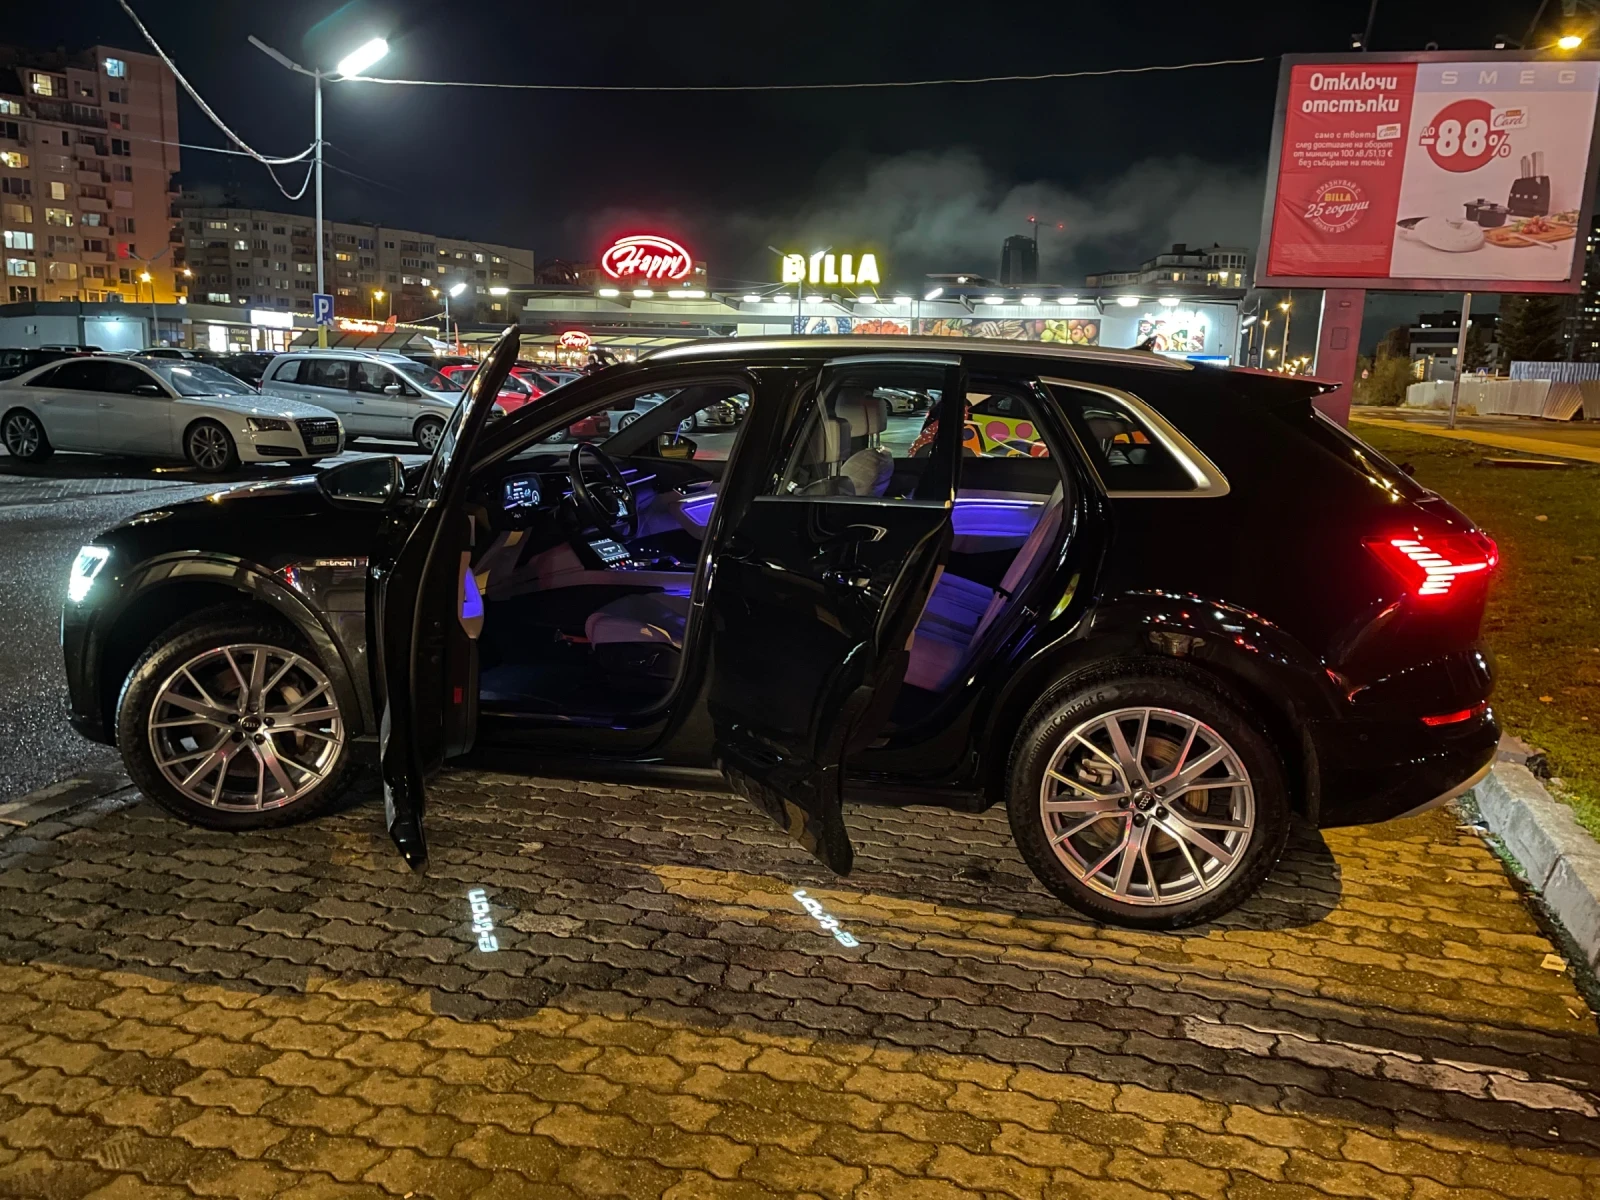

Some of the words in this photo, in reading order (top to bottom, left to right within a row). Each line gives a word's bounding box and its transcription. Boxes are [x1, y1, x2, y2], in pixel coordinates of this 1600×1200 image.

[1310, 72, 1397, 91] Отключи
[1441, 70, 1577, 84] SMEG
[1302, 93, 1399, 113] отстъпки
[1493, 113, 1525, 127] Card
[1343, 130, 1376, 139] твоята
[1420, 119, 1511, 157] -88%
[1295, 142, 1312, 150] след
[1313, 142, 1353, 150] достигане
[1364, 141, 1393, 151] оборот
[1305, 150, 1339, 159] минимум
[1341, 150, 1353, 158] 100
[1387, 150, 1393, 158] €
[1298, 158, 1312, 168] без
[1313, 159, 1349, 168] събиране
[1360, 158, 1386, 166] точки
[1316, 180, 1357, 194] ПРАЗНУВАЙ
[1324, 193, 1351, 201] BILLA
[1304, 202, 1326, 218] 25
[1325, 201, 1370, 218] години
[612, 245, 683, 278] Happy
[782, 253, 880, 284] BILLA
[319, 298, 329, 318] P
[1096, 691, 1105, 702] 6
